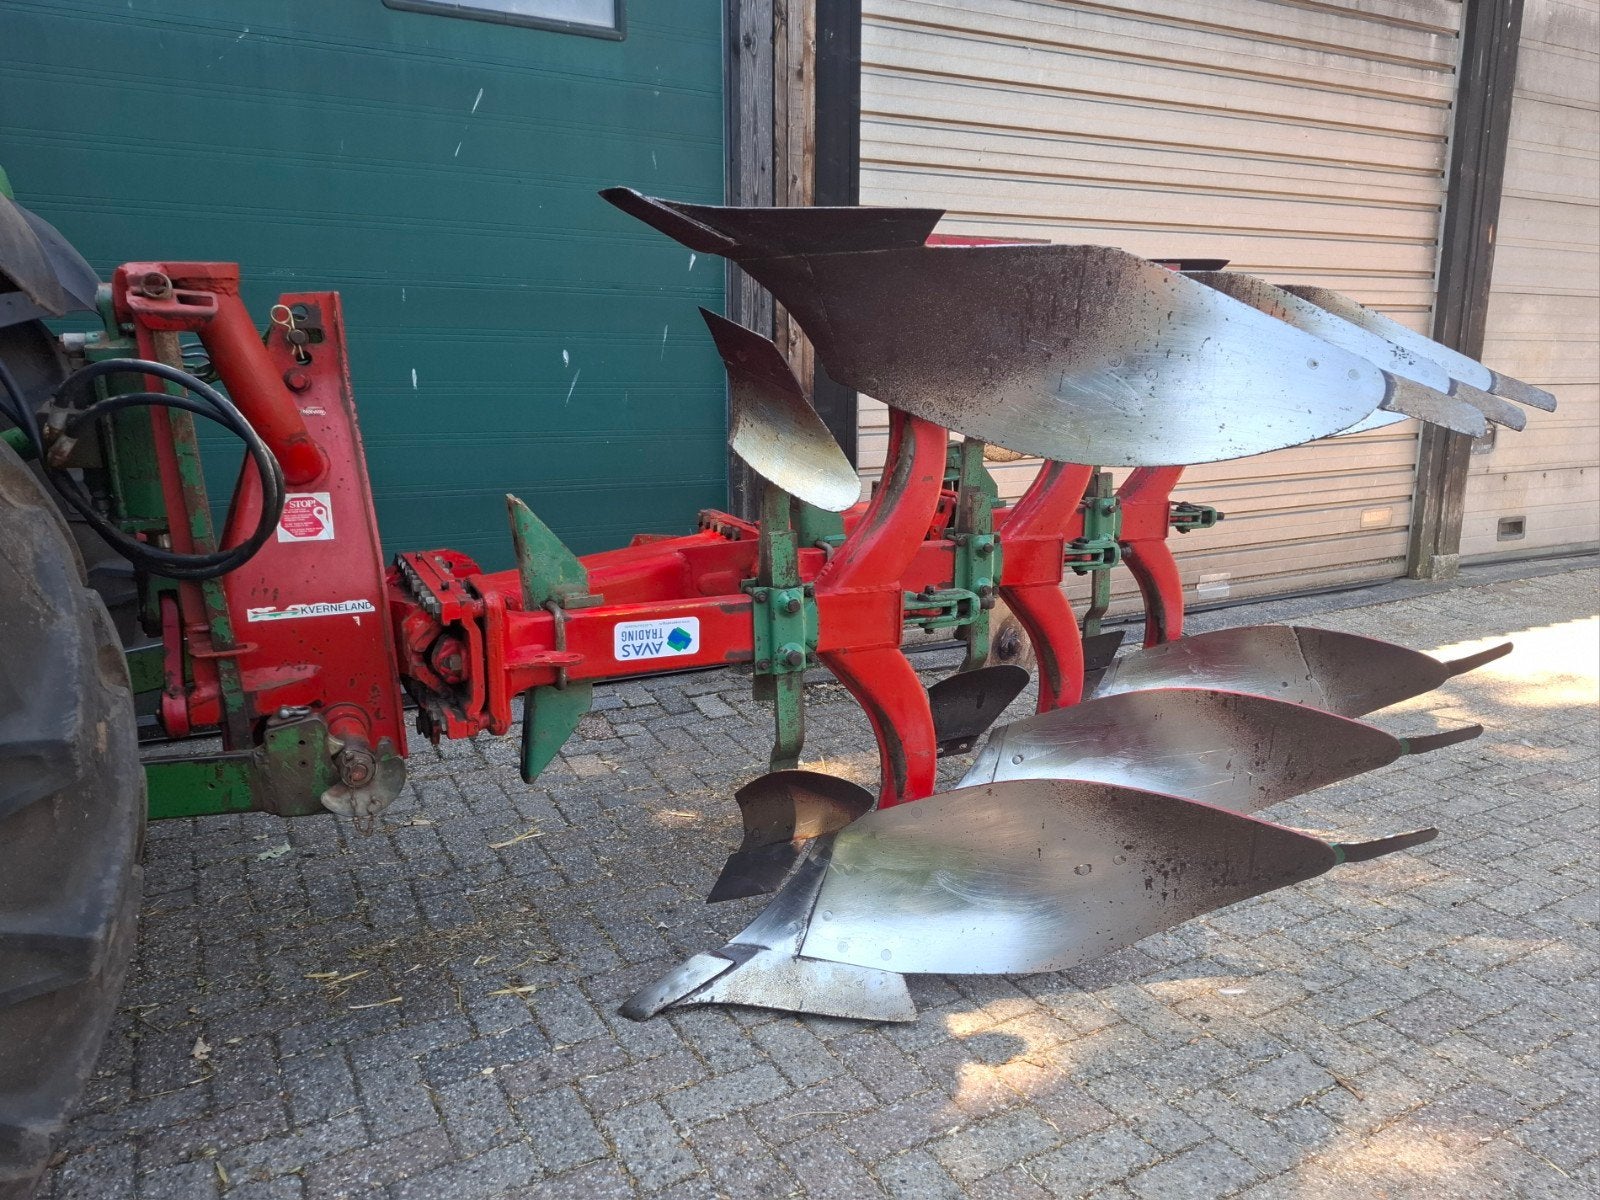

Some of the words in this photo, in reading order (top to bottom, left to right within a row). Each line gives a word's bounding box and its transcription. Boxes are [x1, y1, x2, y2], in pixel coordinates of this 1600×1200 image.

[289, 500, 317, 508] STOP!
[300, 601, 372, 615] KVERNELAND
[621, 628, 664, 642] TRADING
[621, 641, 663, 657] AVAS
